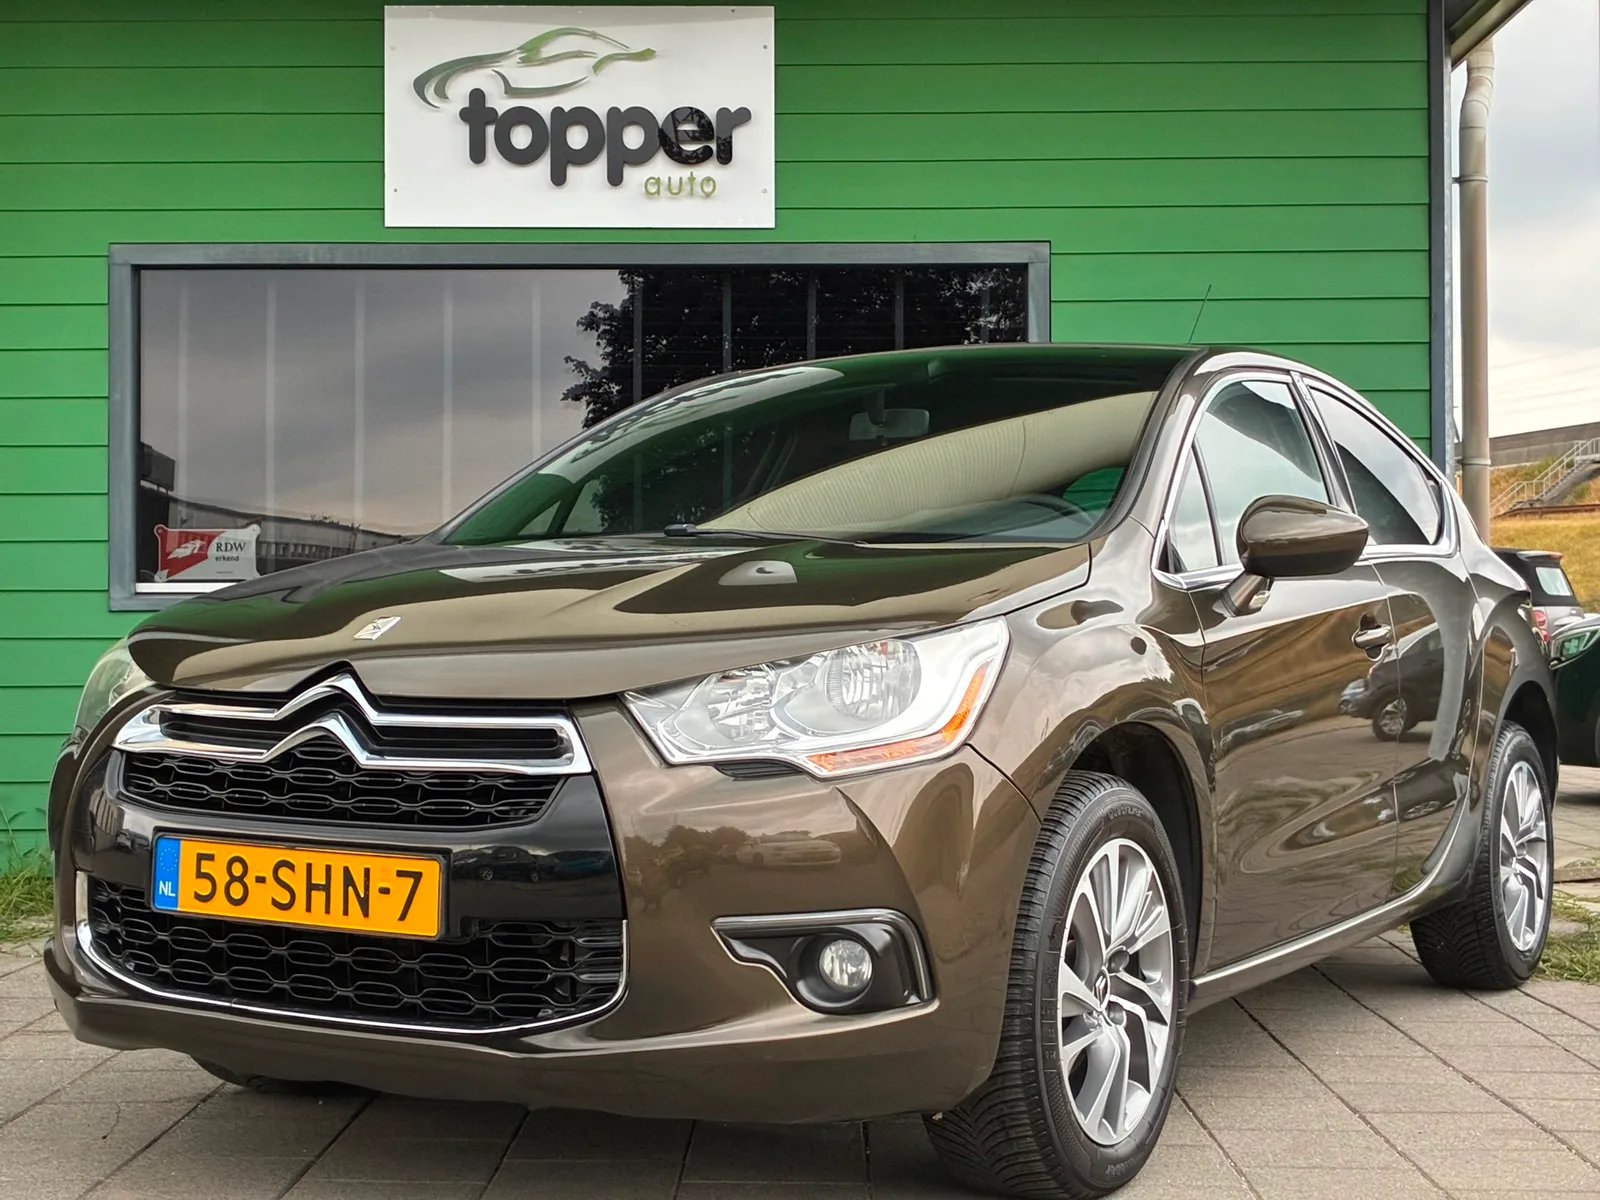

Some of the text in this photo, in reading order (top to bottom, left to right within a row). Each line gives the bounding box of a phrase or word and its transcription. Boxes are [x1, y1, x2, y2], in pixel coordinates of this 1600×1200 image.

[459, 88, 752, 186] topper
[644, 171, 717, 199] auto
[215, 542, 246, 552] RDW
[158, 880, 176, 897] NL
[193, 852, 423, 922] 58-SHN-7
